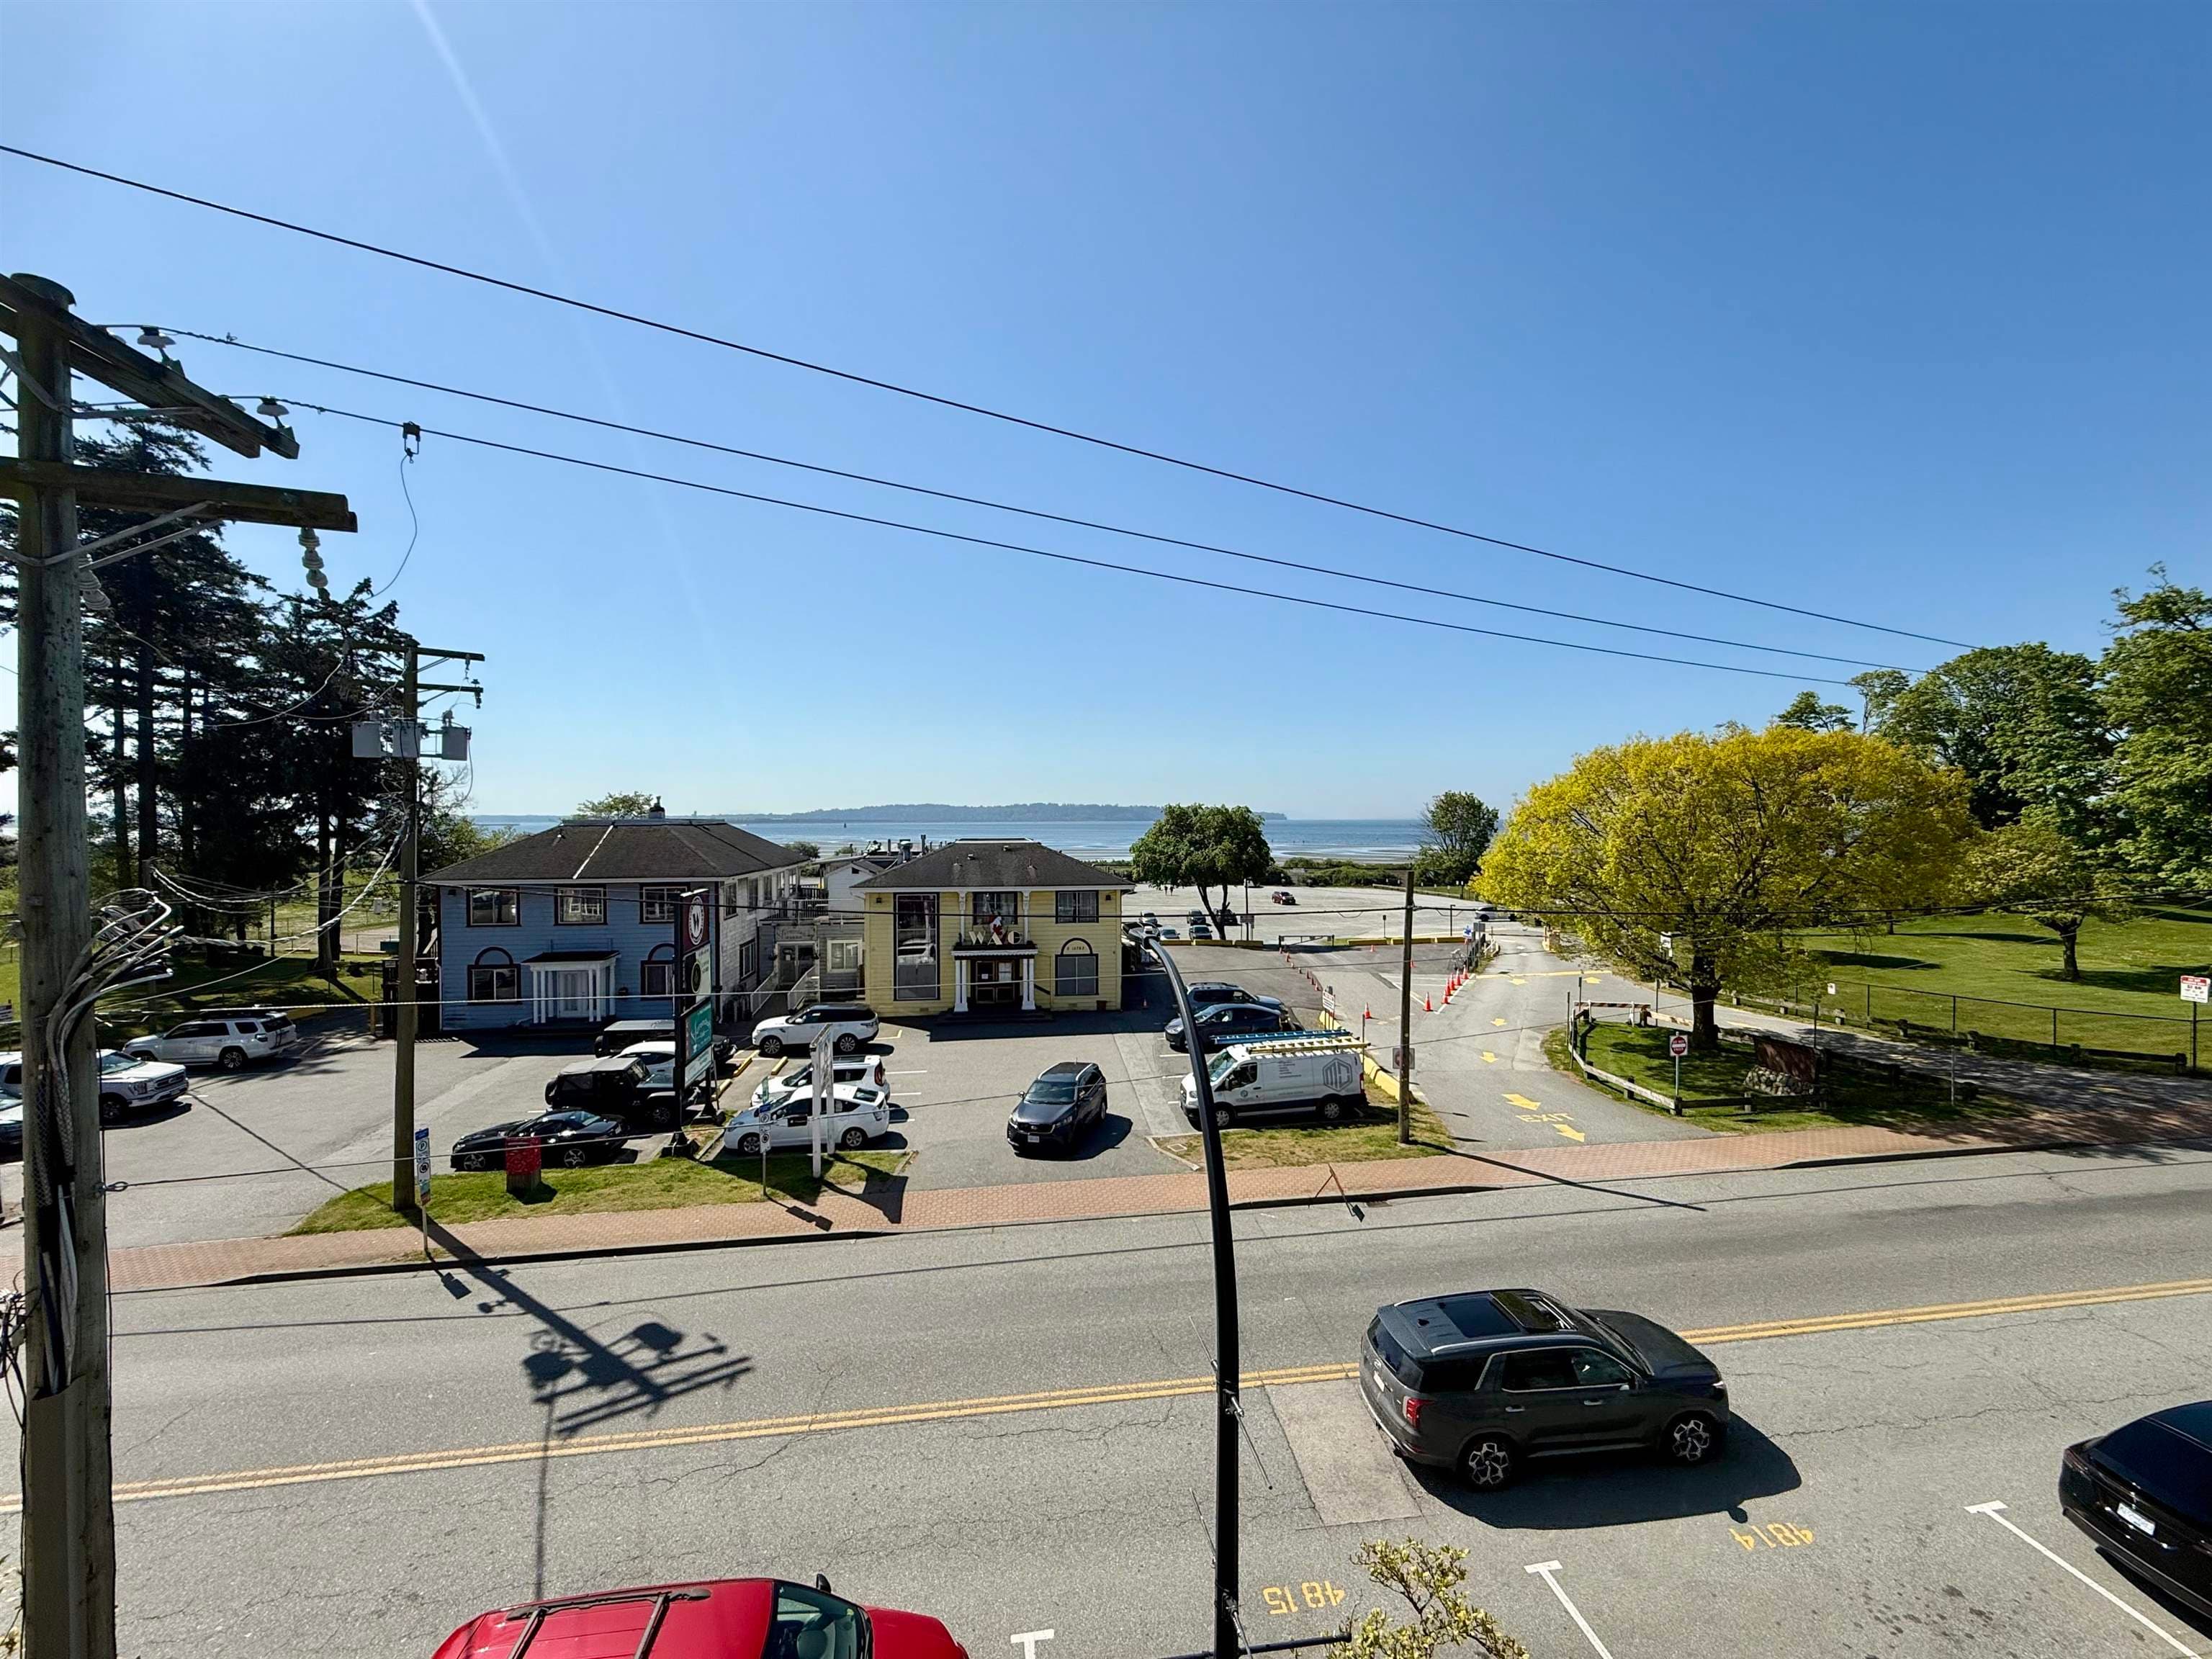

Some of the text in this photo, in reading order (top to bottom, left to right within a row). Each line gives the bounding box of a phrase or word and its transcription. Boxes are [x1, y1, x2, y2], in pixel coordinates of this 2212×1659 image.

[968, 930, 1022, 945] WAG
[1515, 1112, 1574, 1123] EXIT
[1728, 1523, 1813, 1550] 4814
